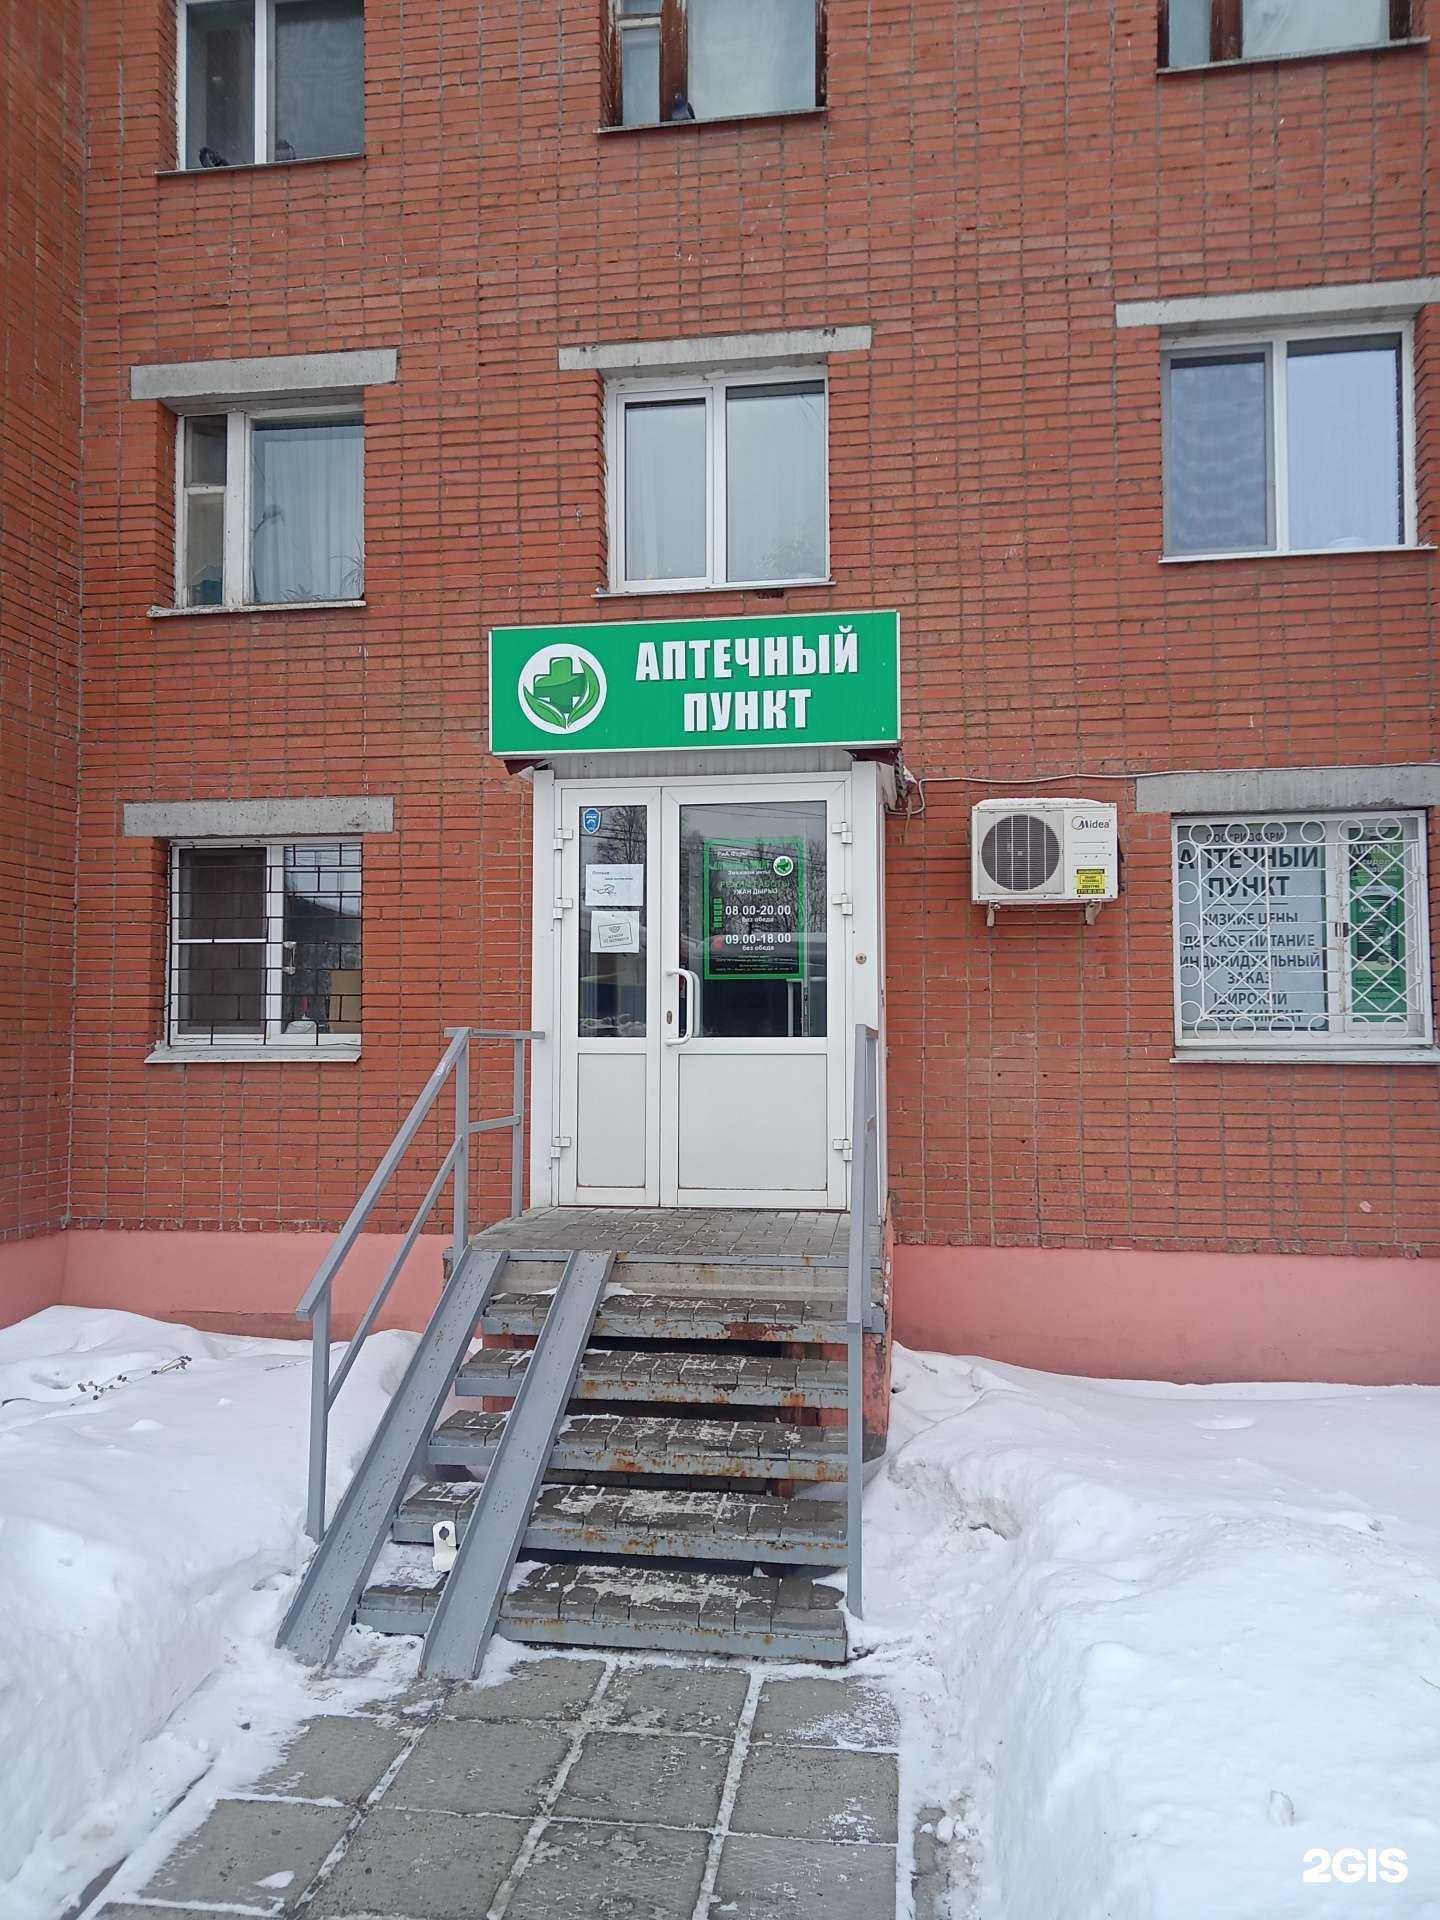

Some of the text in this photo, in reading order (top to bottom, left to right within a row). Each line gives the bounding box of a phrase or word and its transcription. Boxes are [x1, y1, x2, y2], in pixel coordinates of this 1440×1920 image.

[635, 624, 859, 681] АПТЕЧНЫЙ
[683, 688, 812, 732] ПУНКТ
[1072, 816, 1110, 830] Midea
[1208, 876, 1290, 898] ПУНКТ
[725, 905, 792, 916] 08.00-20.00
[725, 932, 792, 945] 09.00-18.00
[1250, 934, 1315, 947] ПИТАНИЕ
